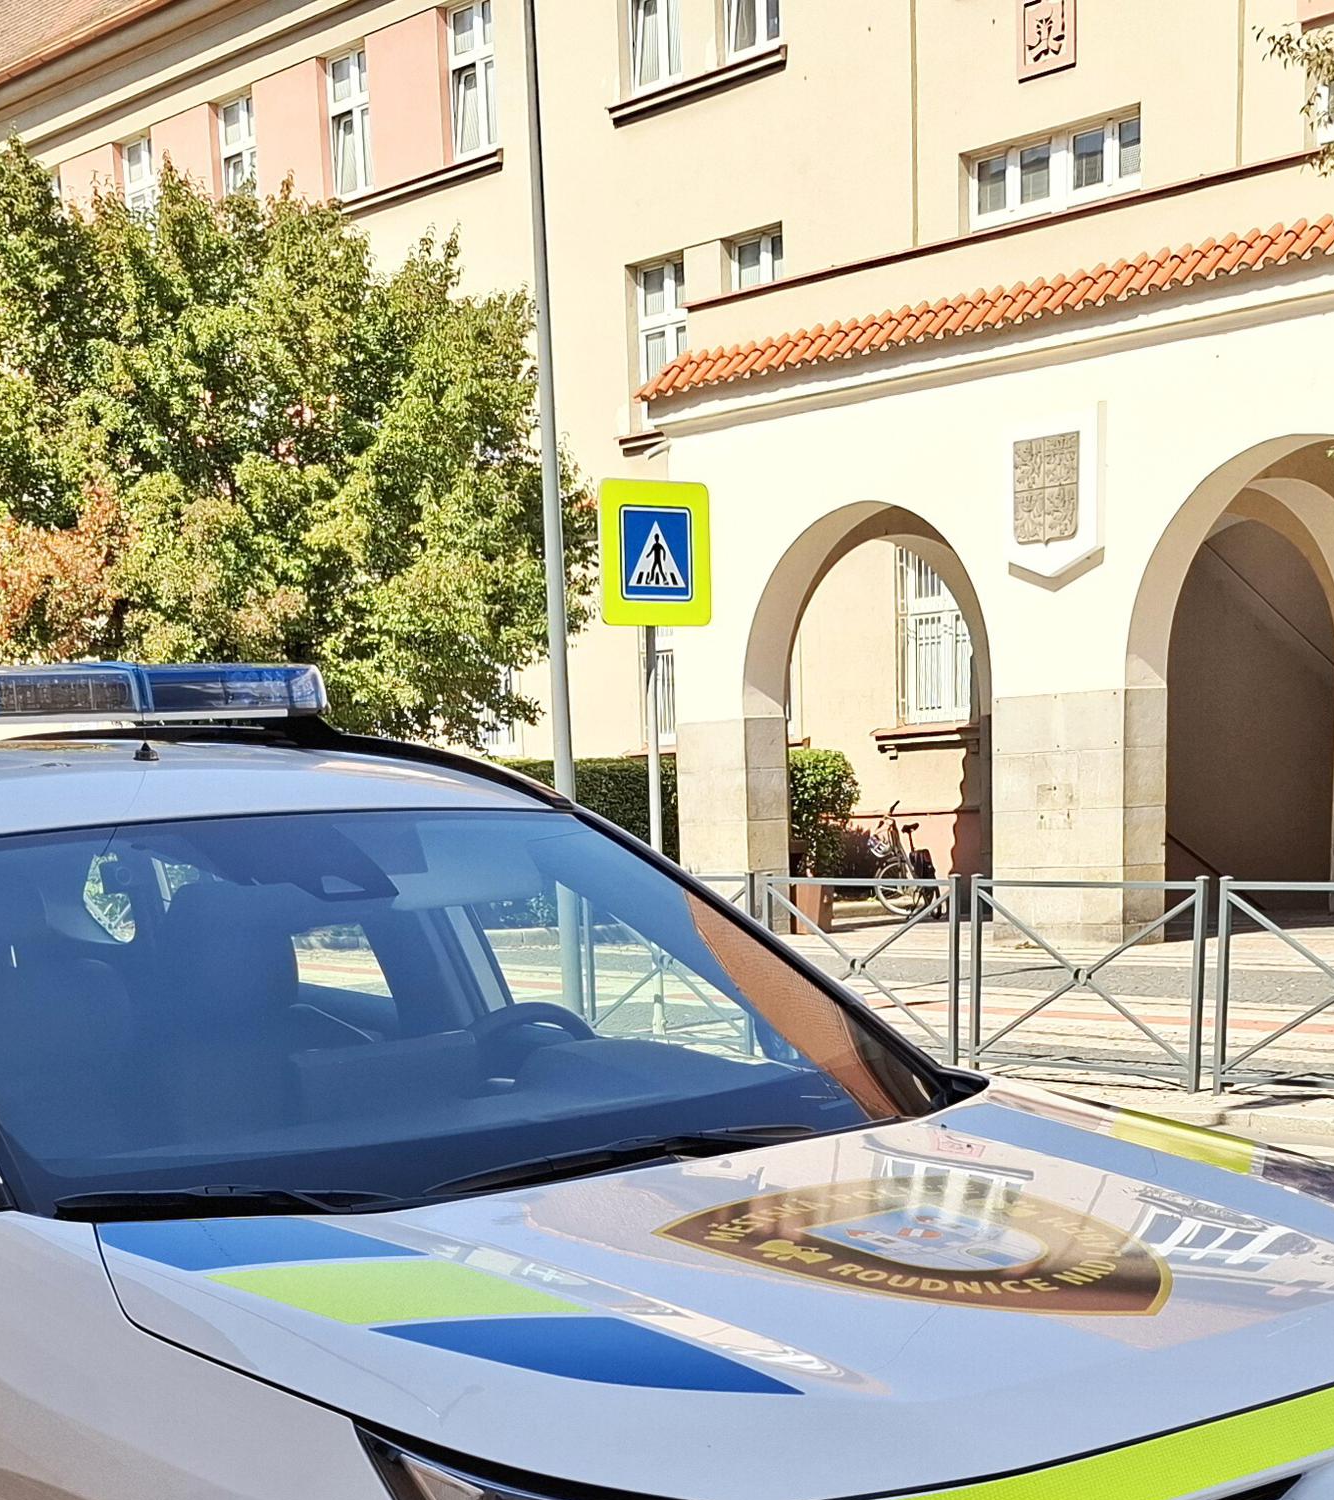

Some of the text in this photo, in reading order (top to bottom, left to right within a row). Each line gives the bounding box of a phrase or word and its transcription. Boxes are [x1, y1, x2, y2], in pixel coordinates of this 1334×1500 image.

[704, 1197, 831, 1243] MĚSTSKÁ
[827, 1262, 1059, 1295] ROUDNICE
[1052, 1259, 1117, 1286] NAD
